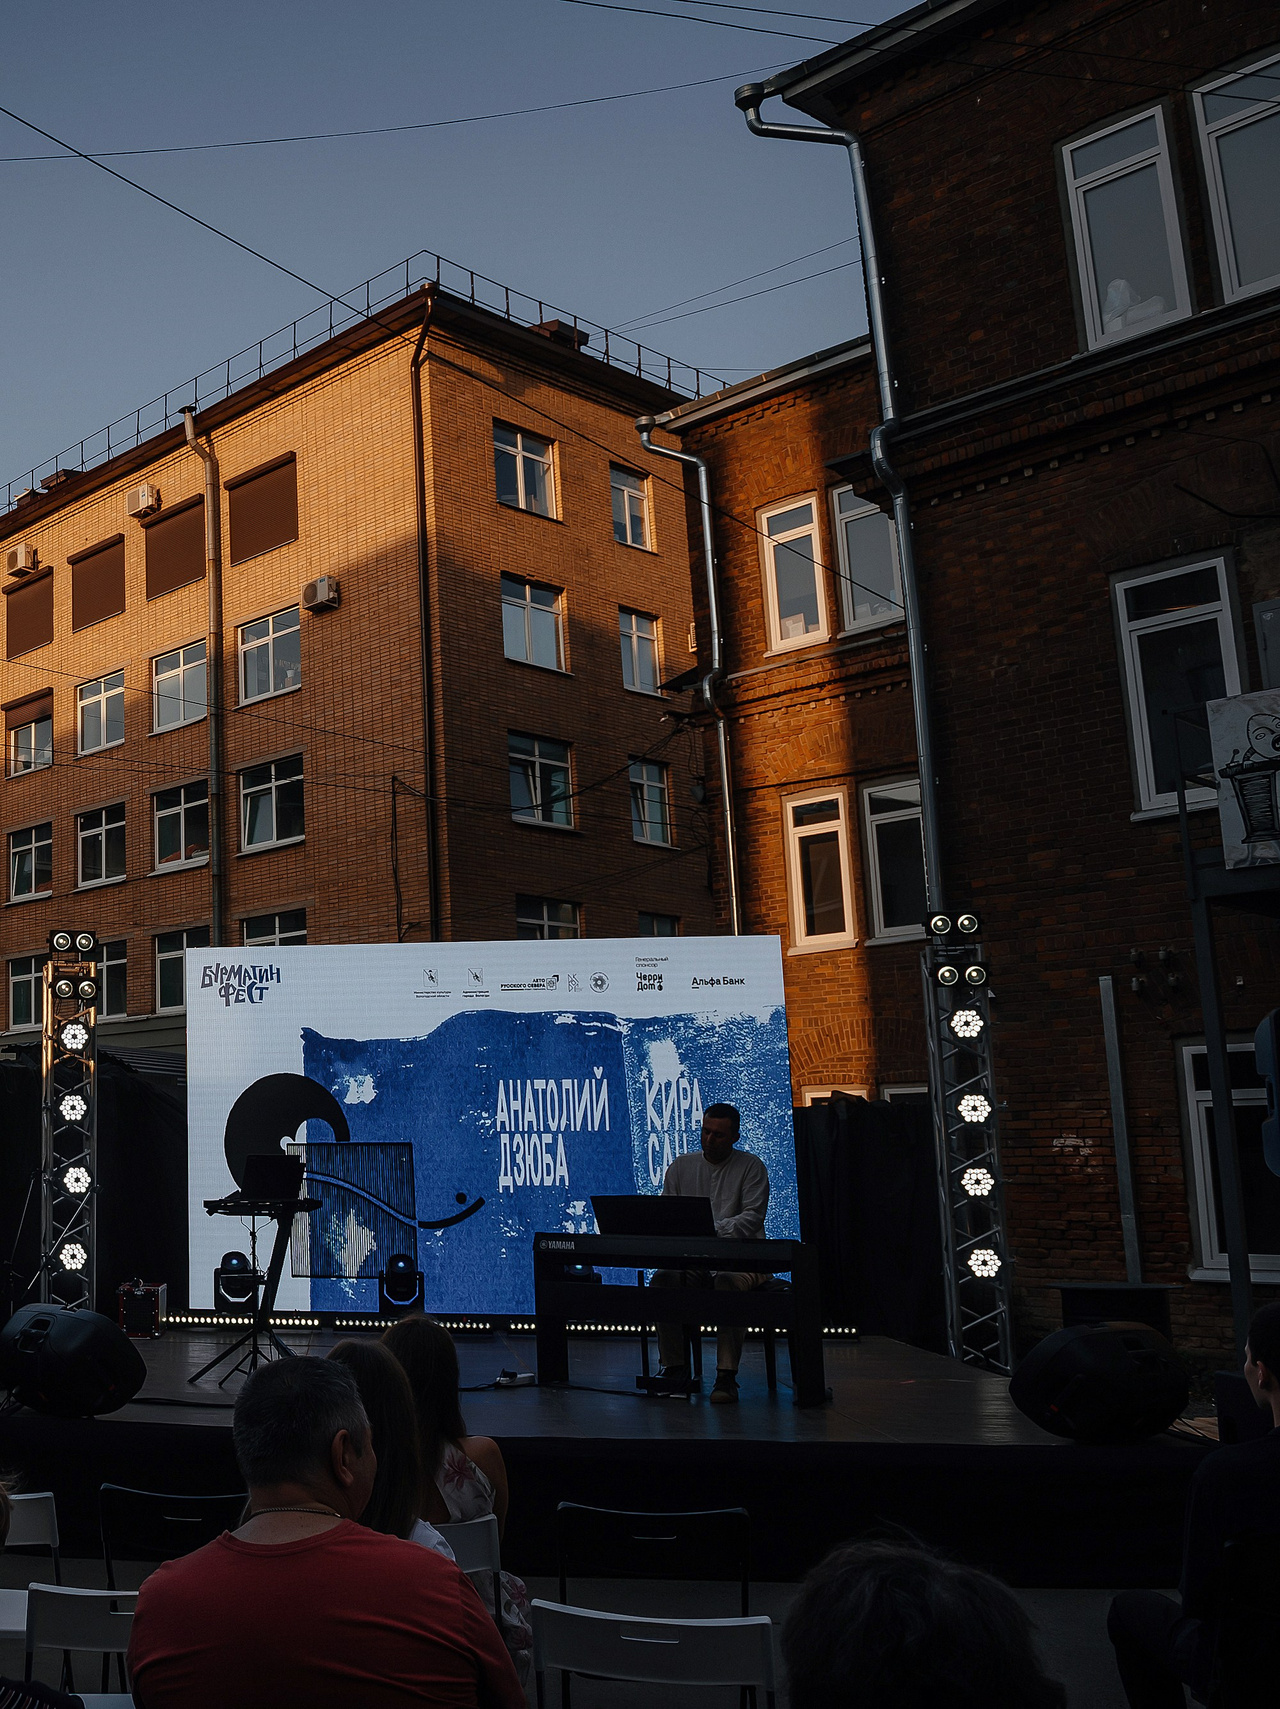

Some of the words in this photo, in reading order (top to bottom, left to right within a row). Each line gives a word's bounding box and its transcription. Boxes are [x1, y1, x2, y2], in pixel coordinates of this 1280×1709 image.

[636, 972, 663, 983] Черри
[637, 982, 656, 991] Дом
[691, 977, 721, 987] Альфа
[722, 976, 745, 986] Банк
[219, 981, 269, 1007] ФЕСТ
[496, 1066, 610, 1132] АНАТОЛИЙ
[645, 1078, 704, 1131] КИРА
[498, 1133, 569, 1193] ДЗЮБА
[548, 1240, 575, 1250] YAMAHA
